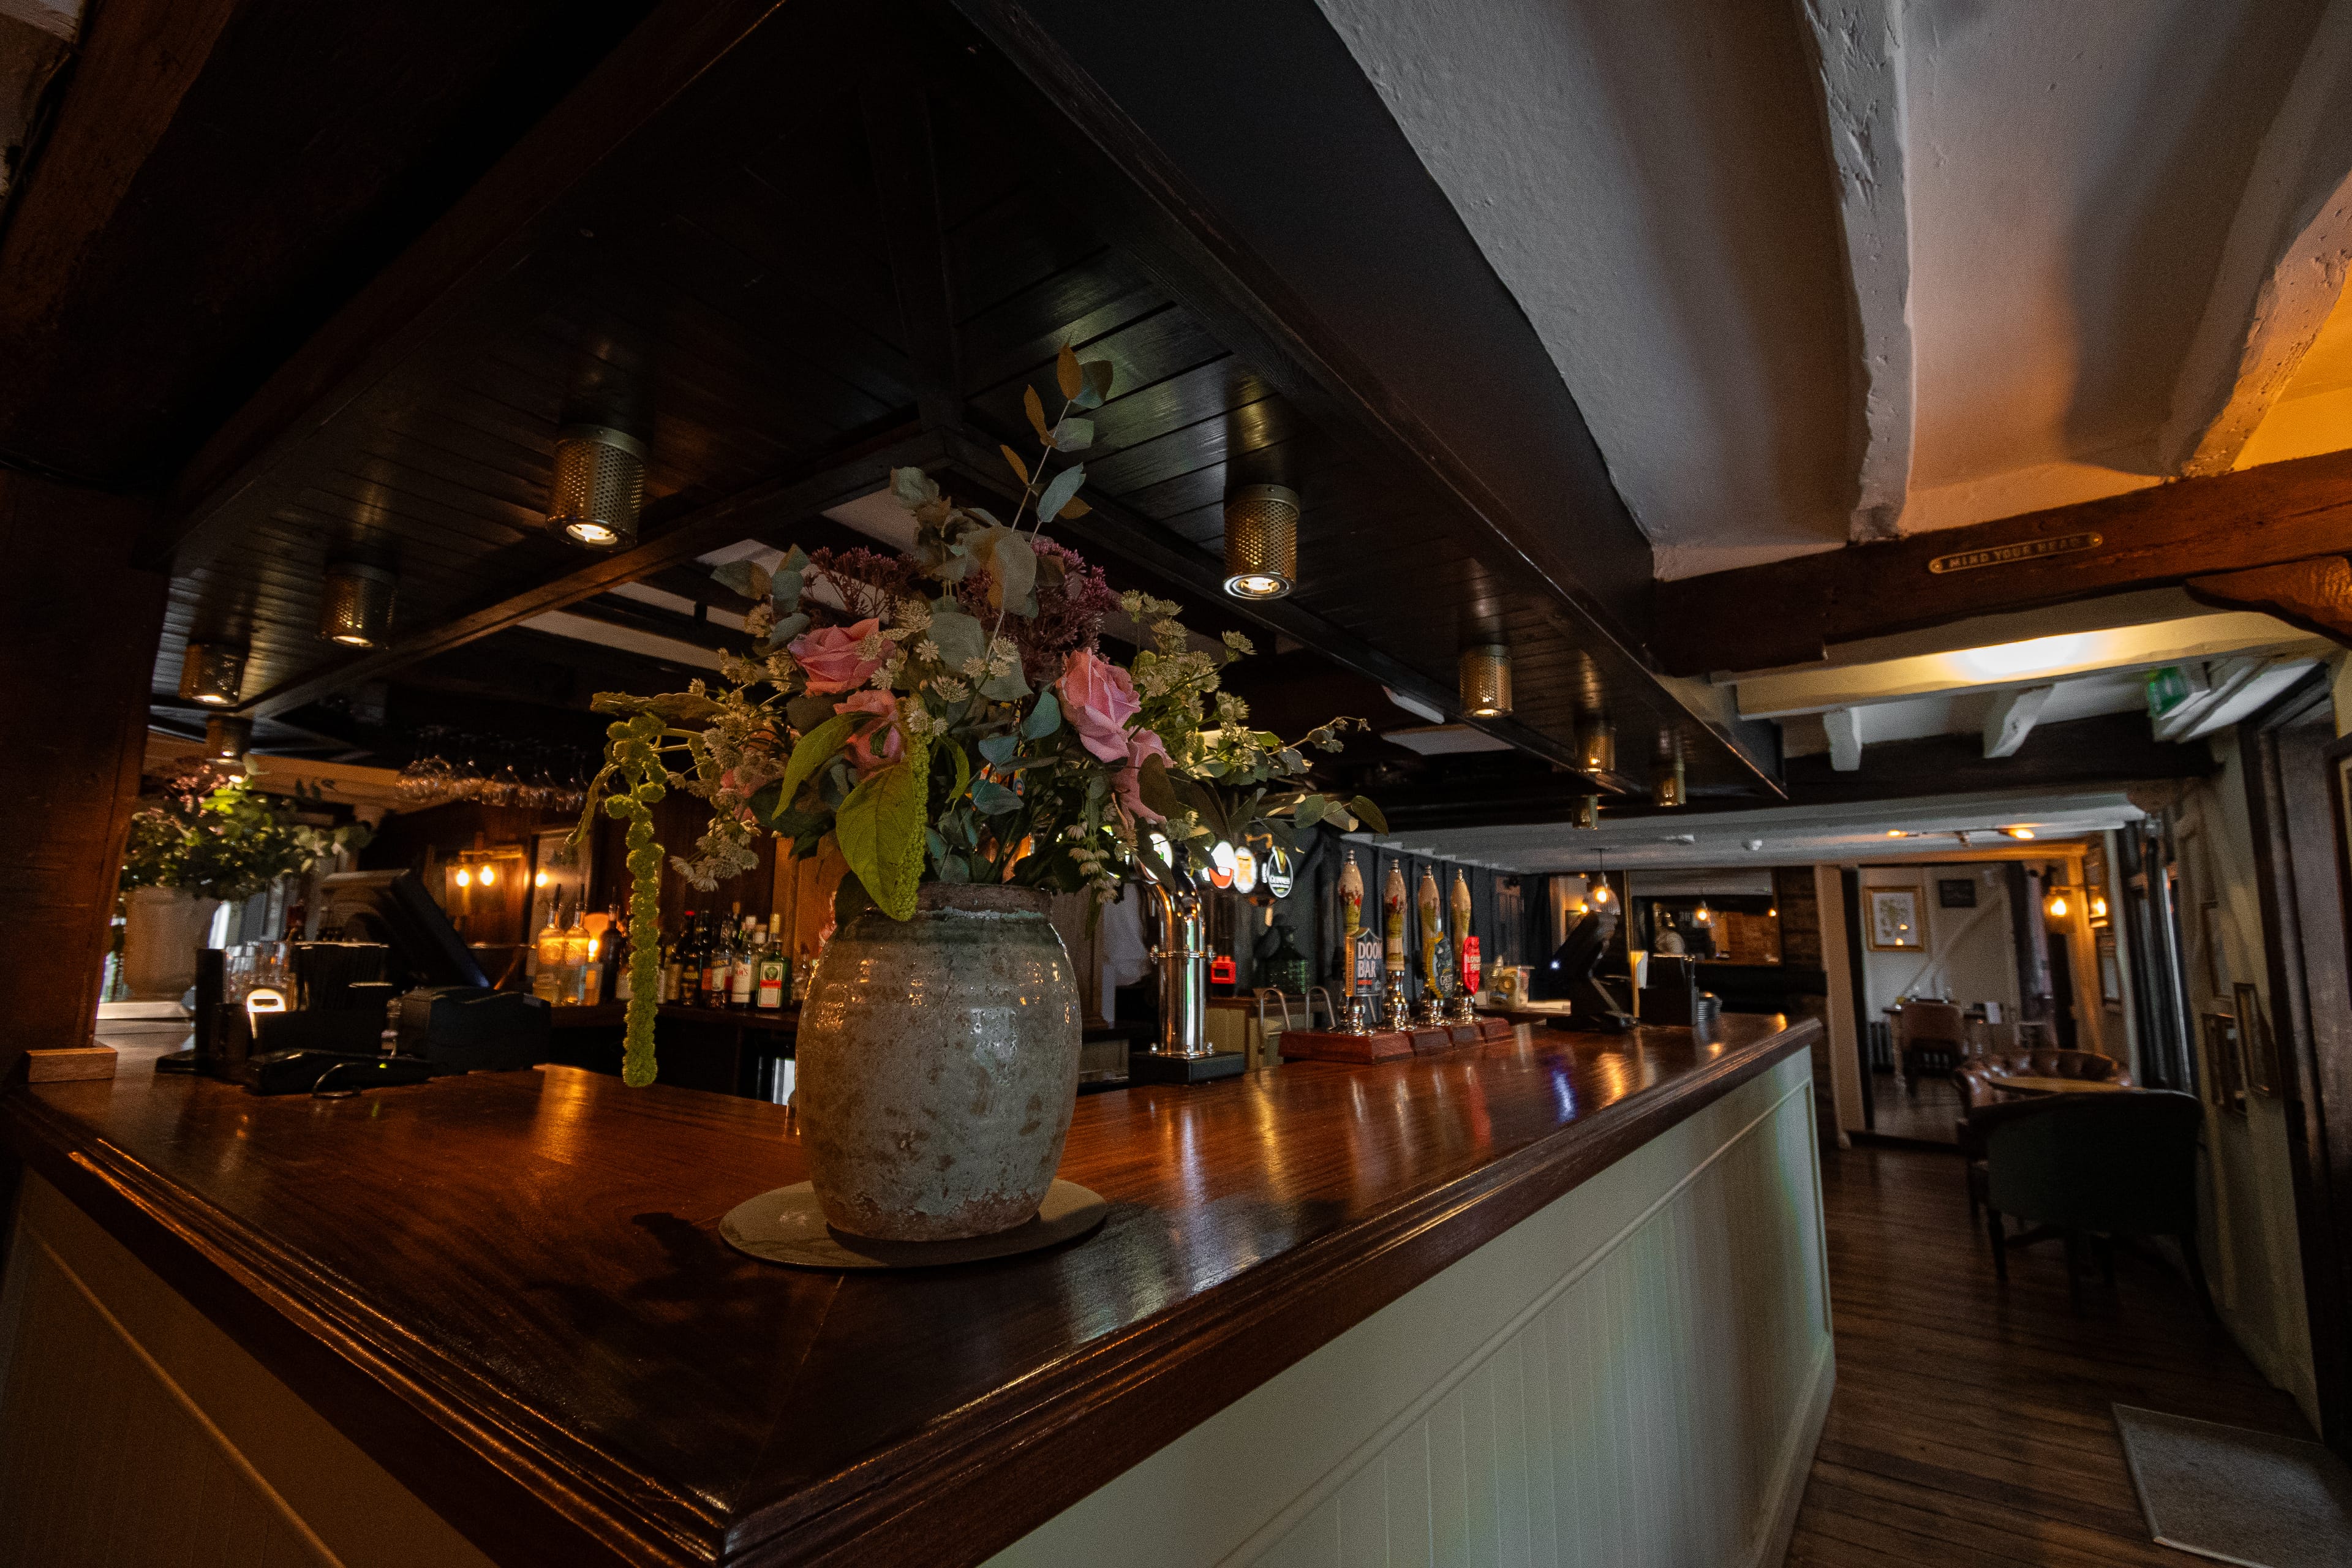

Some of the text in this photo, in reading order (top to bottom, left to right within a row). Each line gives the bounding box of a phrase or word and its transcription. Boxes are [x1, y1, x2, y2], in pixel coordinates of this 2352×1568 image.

[1948, 554, 1990, 568] MIND
[1993, 546, 2030, 561] YOUR
[1357, 941, 1382, 960] DOOM
[1357, 960, 1376, 978] BAR
